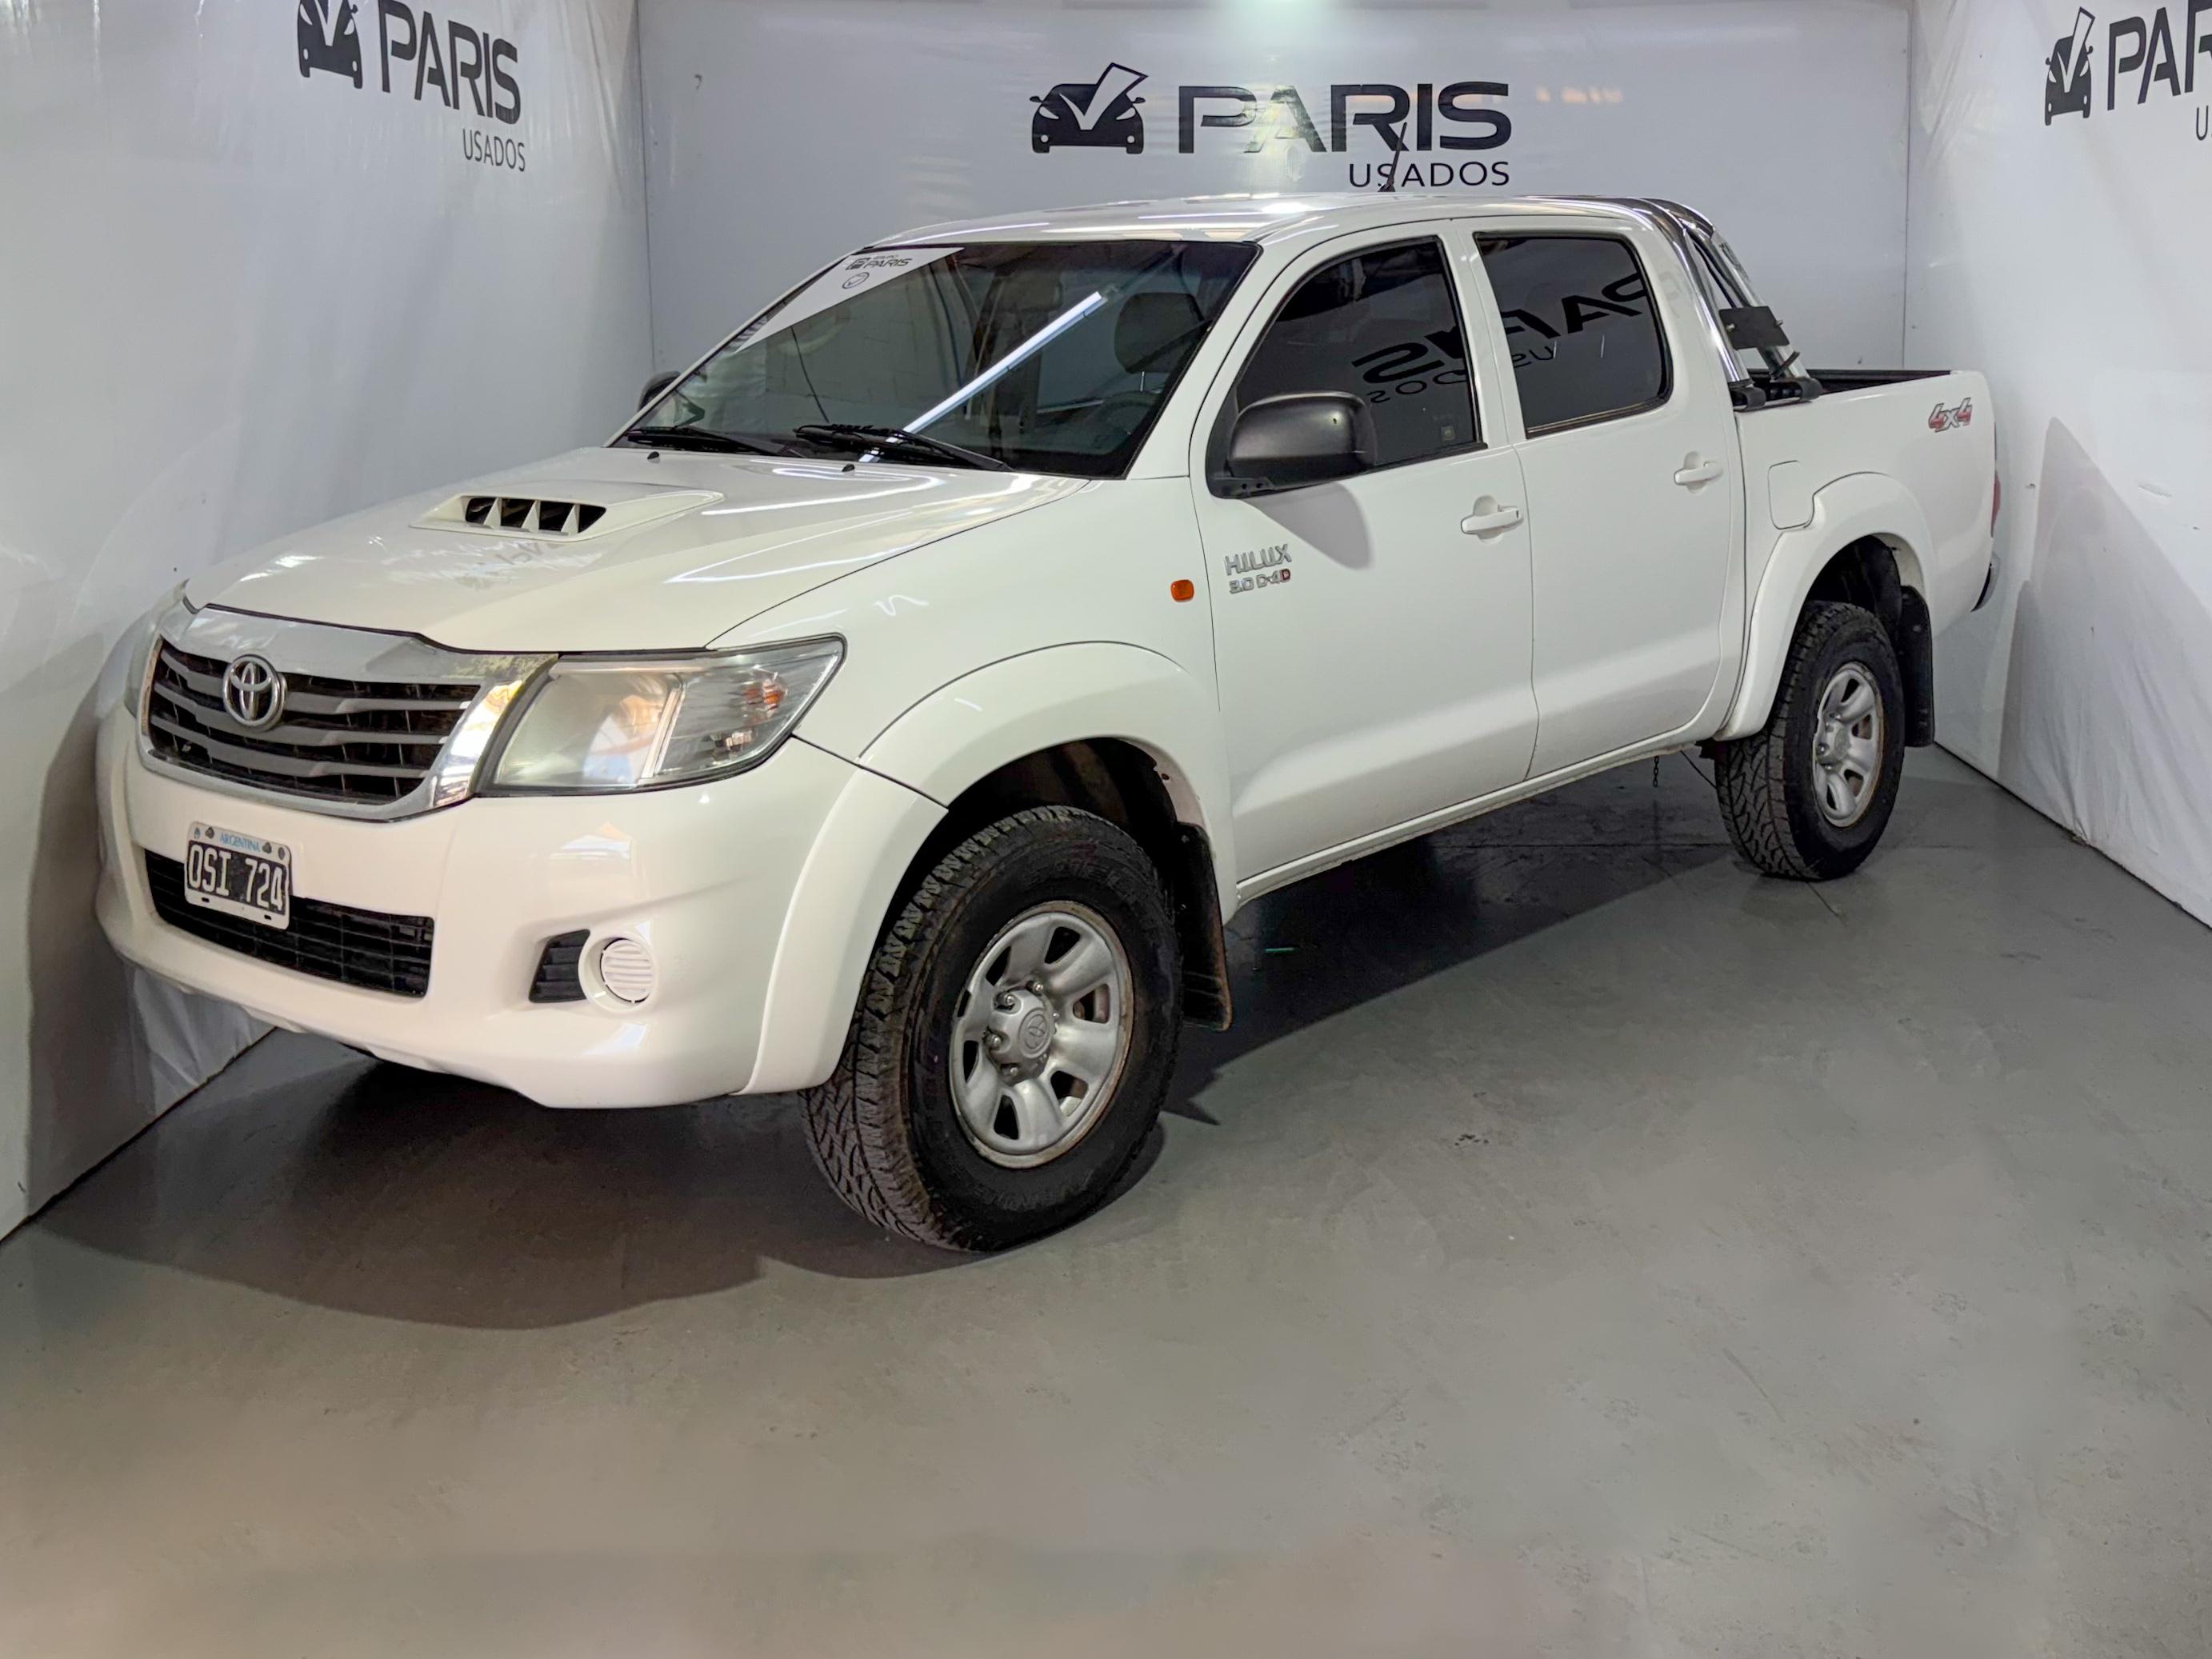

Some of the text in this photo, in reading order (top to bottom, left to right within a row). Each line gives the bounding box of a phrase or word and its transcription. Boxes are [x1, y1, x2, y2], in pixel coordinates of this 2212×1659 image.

[378, 0, 522, 125] PARIS
[1178, 82, 1511, 154] PARIS
[462, 128, 526, 172] USADOS
[863, 258, 913, 269] PARIS
[1224, 544, 1292, 576] HILUX
[220, 833, 261, 853] ARGENTINA
[245, 857, 283, 911] 724
